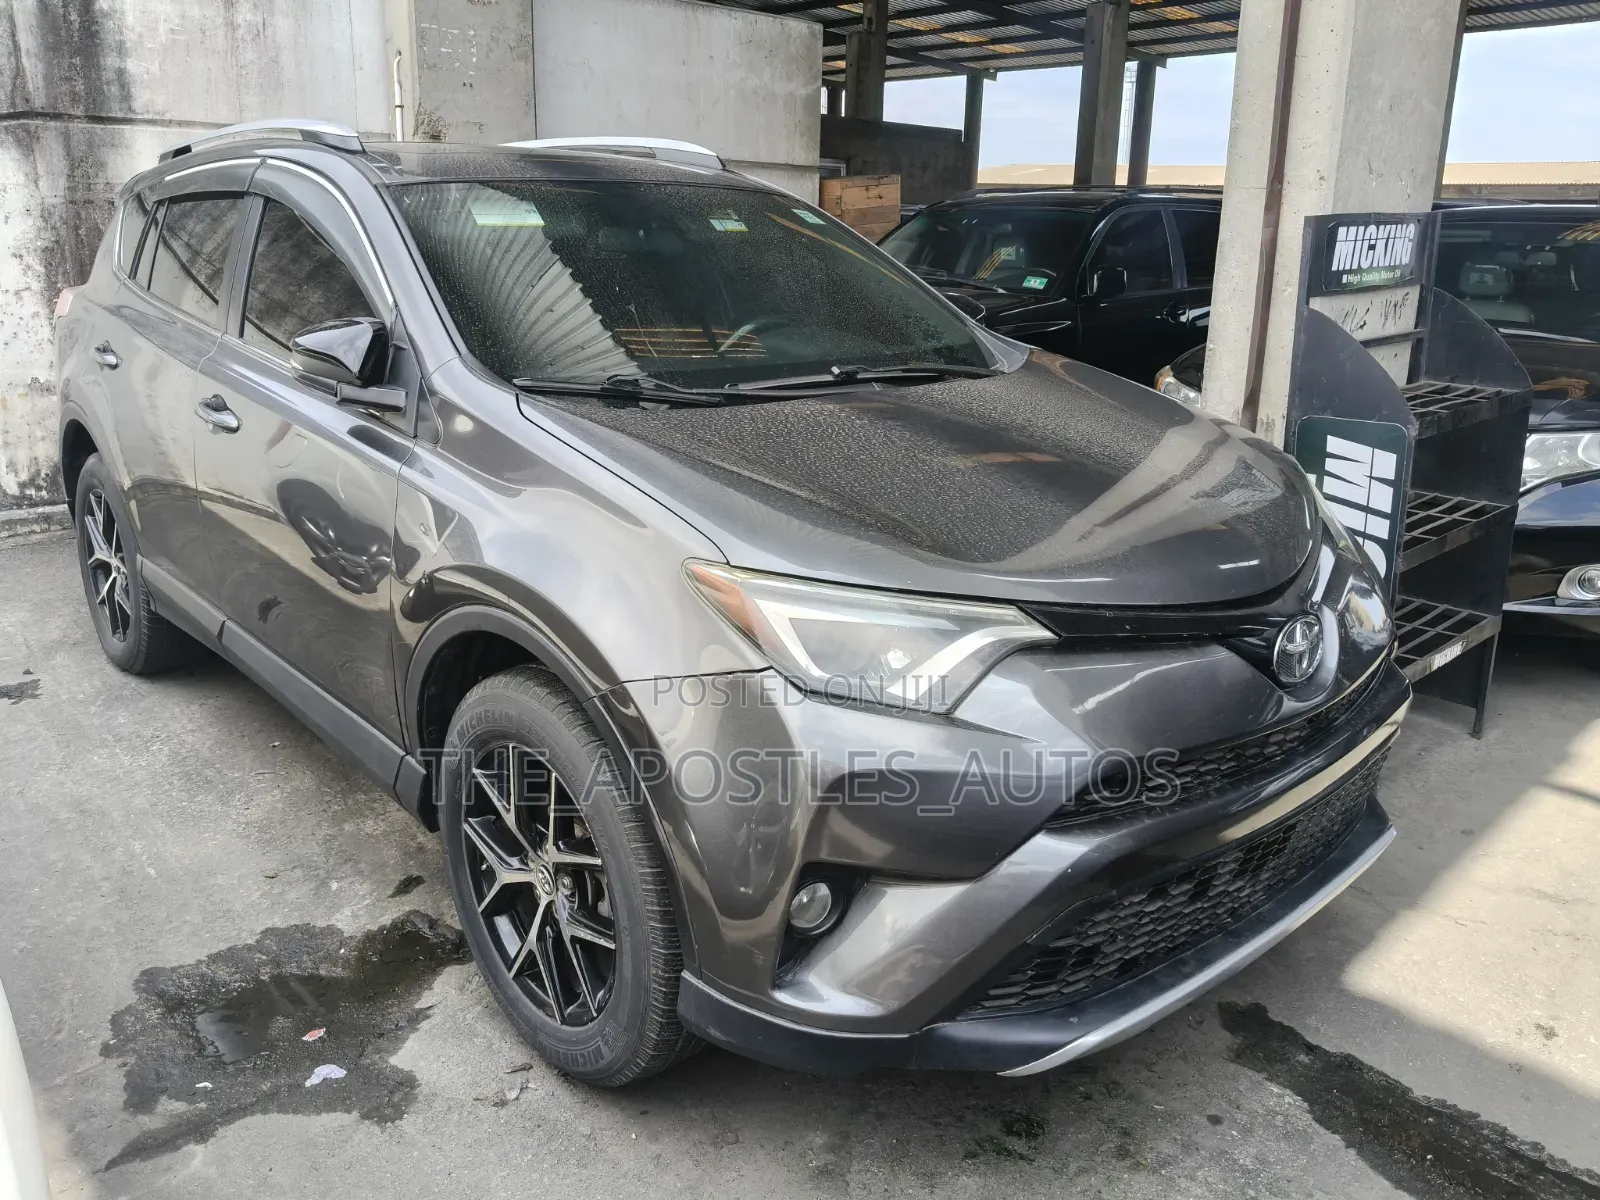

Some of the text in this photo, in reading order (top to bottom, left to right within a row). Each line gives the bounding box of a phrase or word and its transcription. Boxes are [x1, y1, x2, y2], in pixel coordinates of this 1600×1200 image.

[1331, 223, 1415, 271] MICKING
[1347, 273, 1361, 284] High
[1362, 271, 1380, 282] Quality
[1380, 270, 1395, 279] Motor
